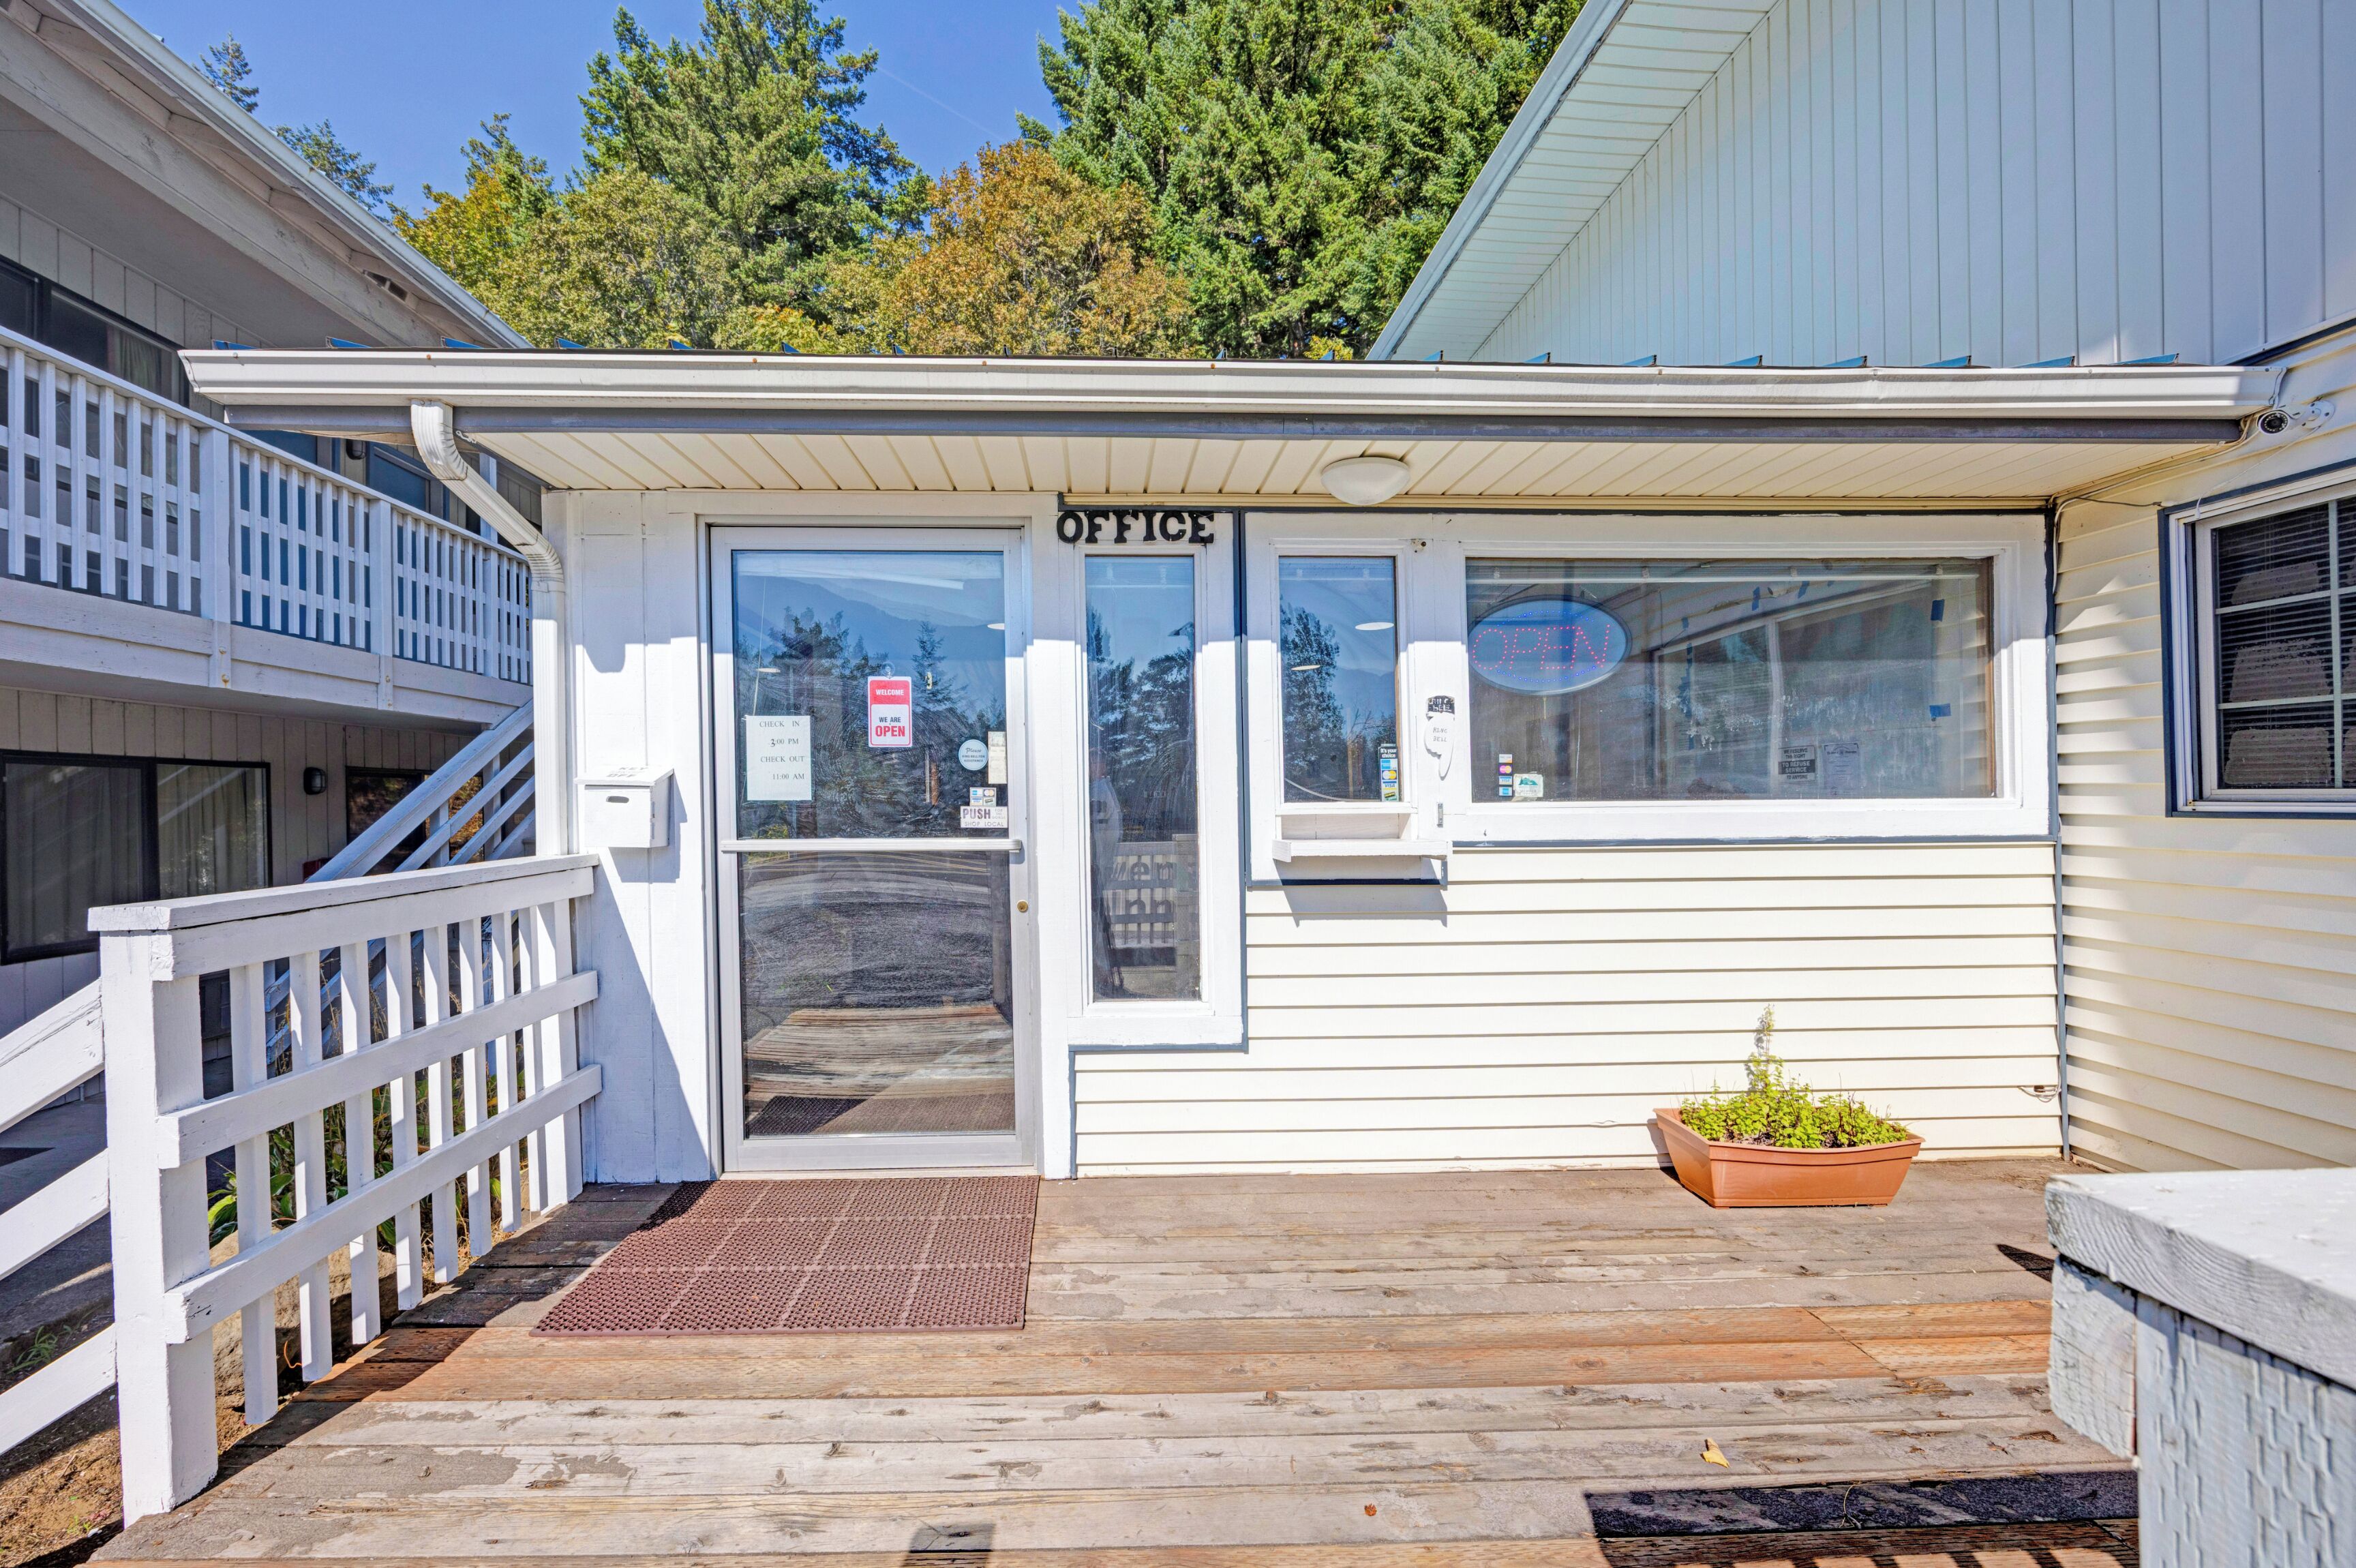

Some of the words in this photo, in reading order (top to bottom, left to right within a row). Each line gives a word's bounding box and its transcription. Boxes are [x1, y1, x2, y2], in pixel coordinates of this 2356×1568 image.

[1057, 510, 1215, 544] OFFICE
[1472, 624, 1610, 670] OPEN
[875, 725, 905, 737] OPEN
[963, 808, 991, 819] PUSH
